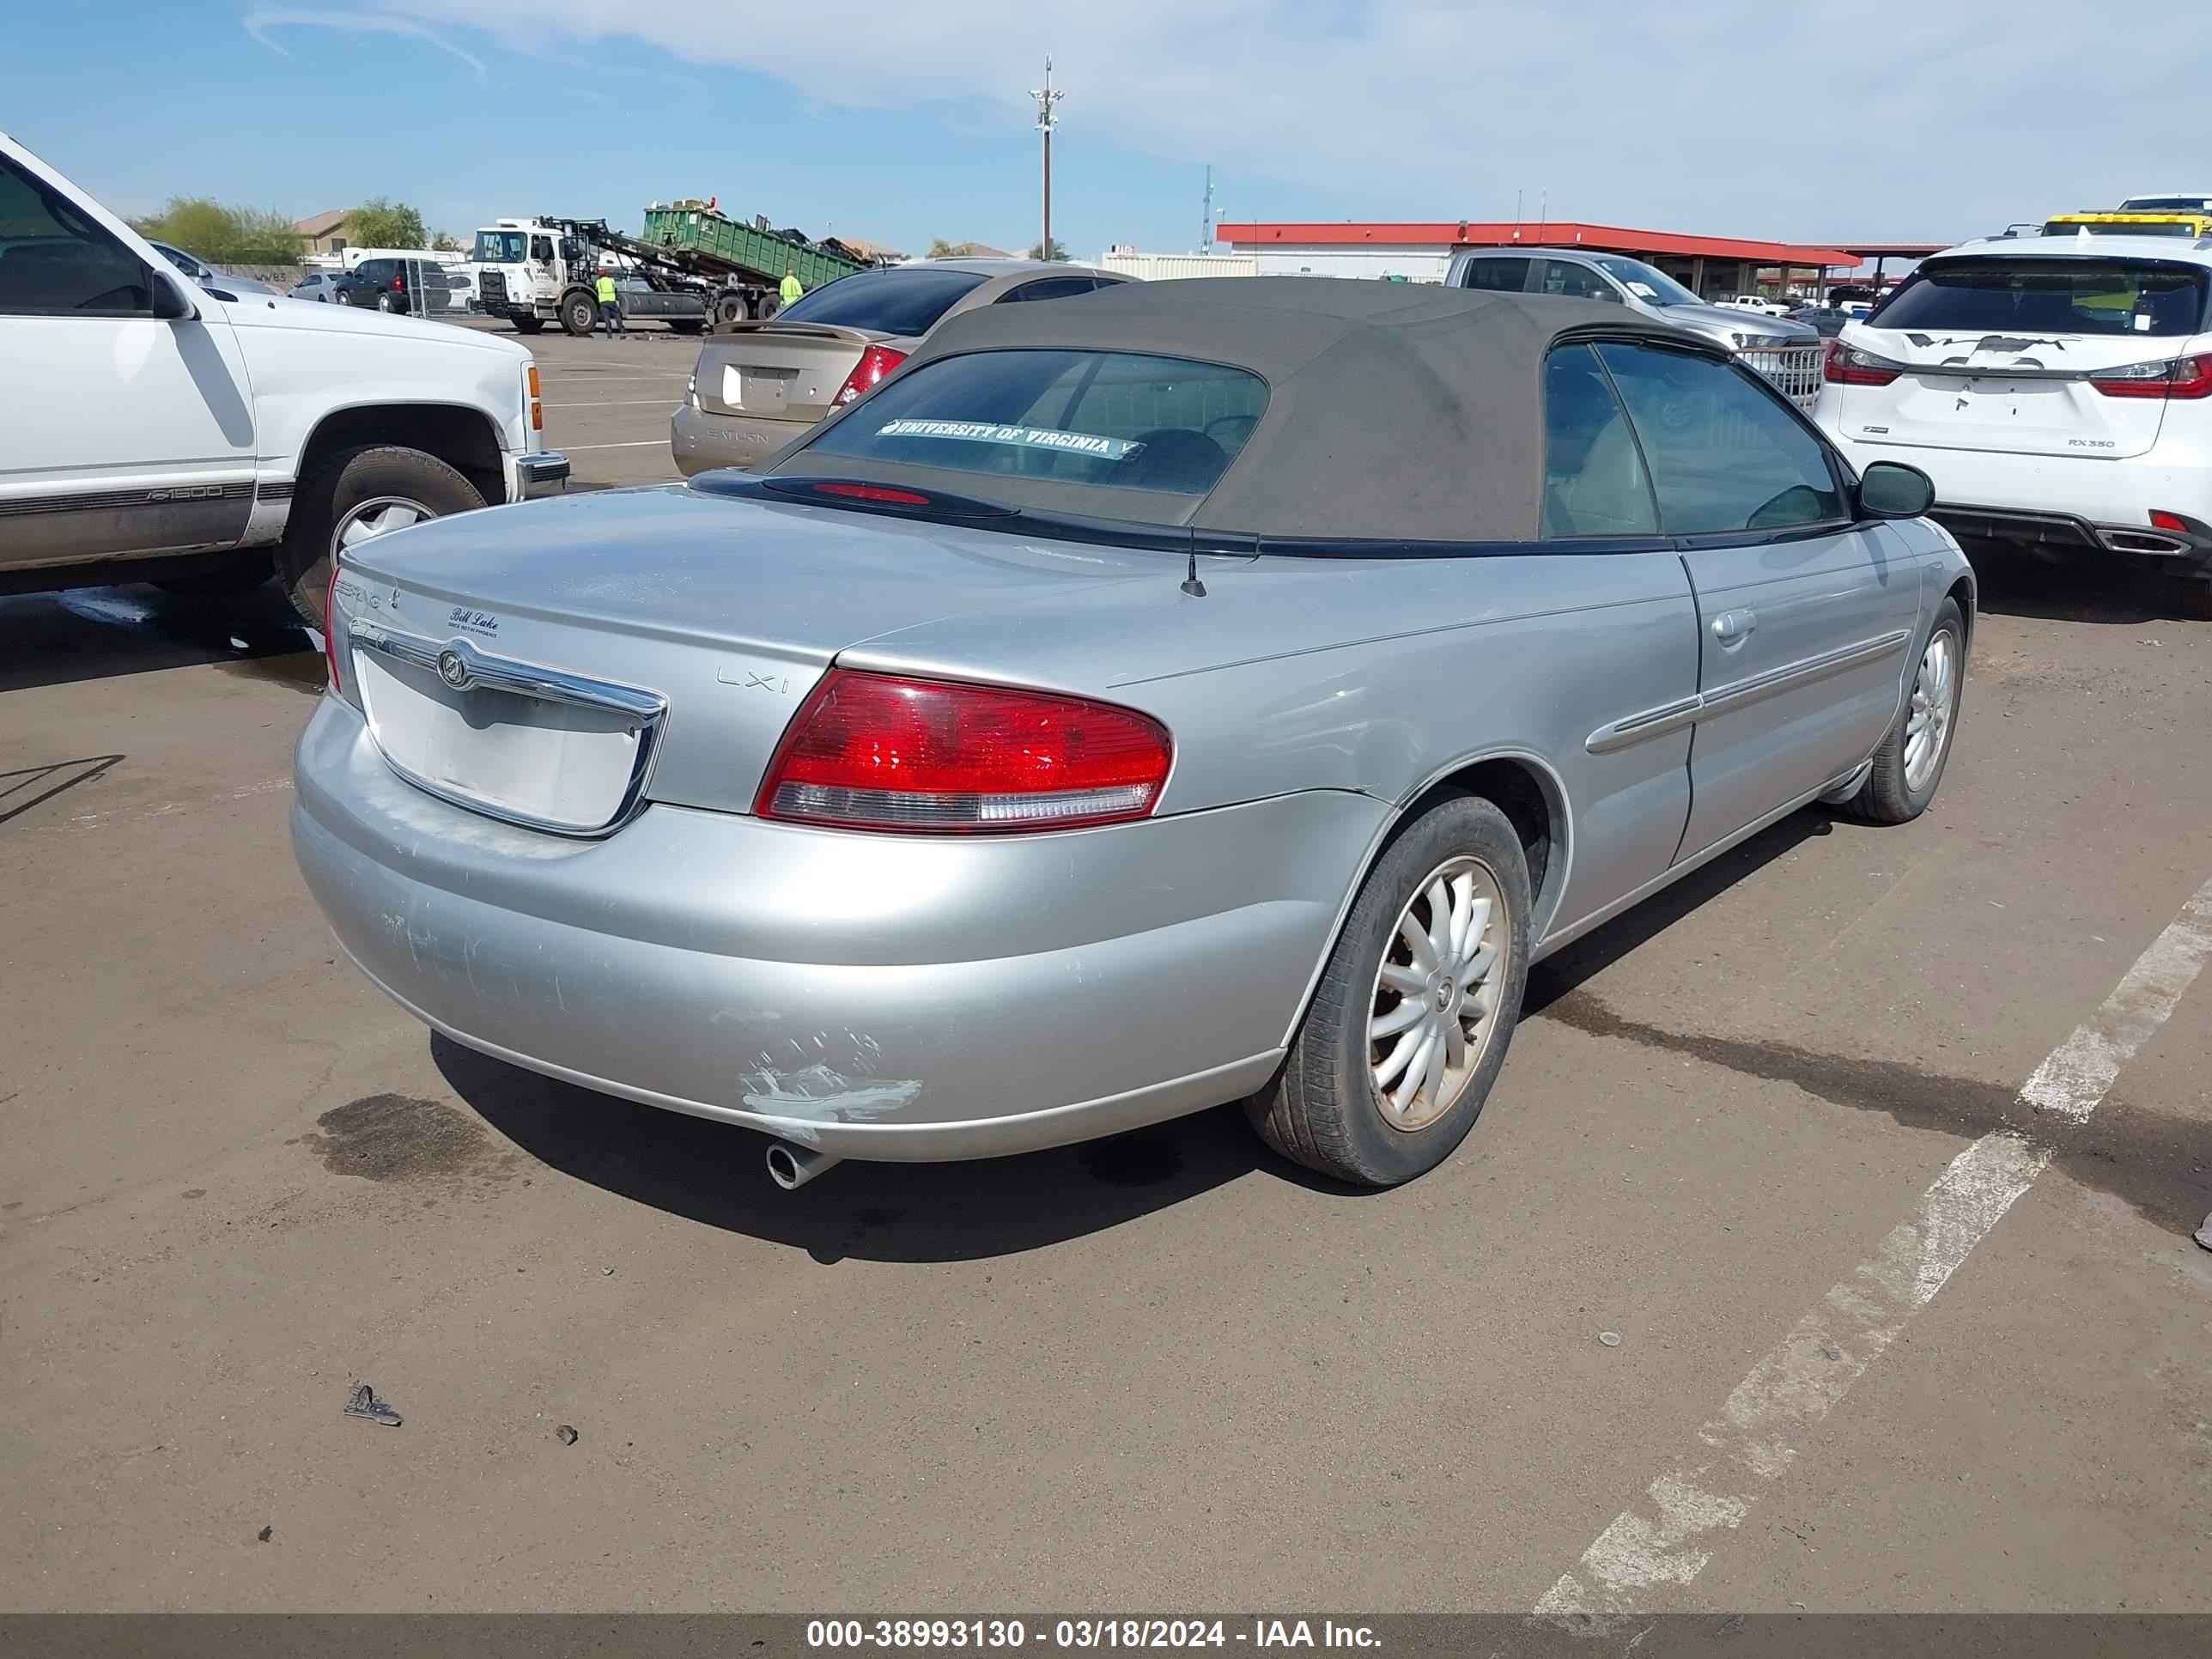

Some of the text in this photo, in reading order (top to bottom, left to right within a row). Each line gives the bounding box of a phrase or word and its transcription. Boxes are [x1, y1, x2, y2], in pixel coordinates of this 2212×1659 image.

[707, 428, 770, 445] SATURN
[896, 422, 1110, 453] UNIVERSITY OF VIRGINIA
[2068, 439, 2116, 448] RX 350
[169, 485, 223, 500] 1500
[449, 607, 499, 630] Bill Luke
